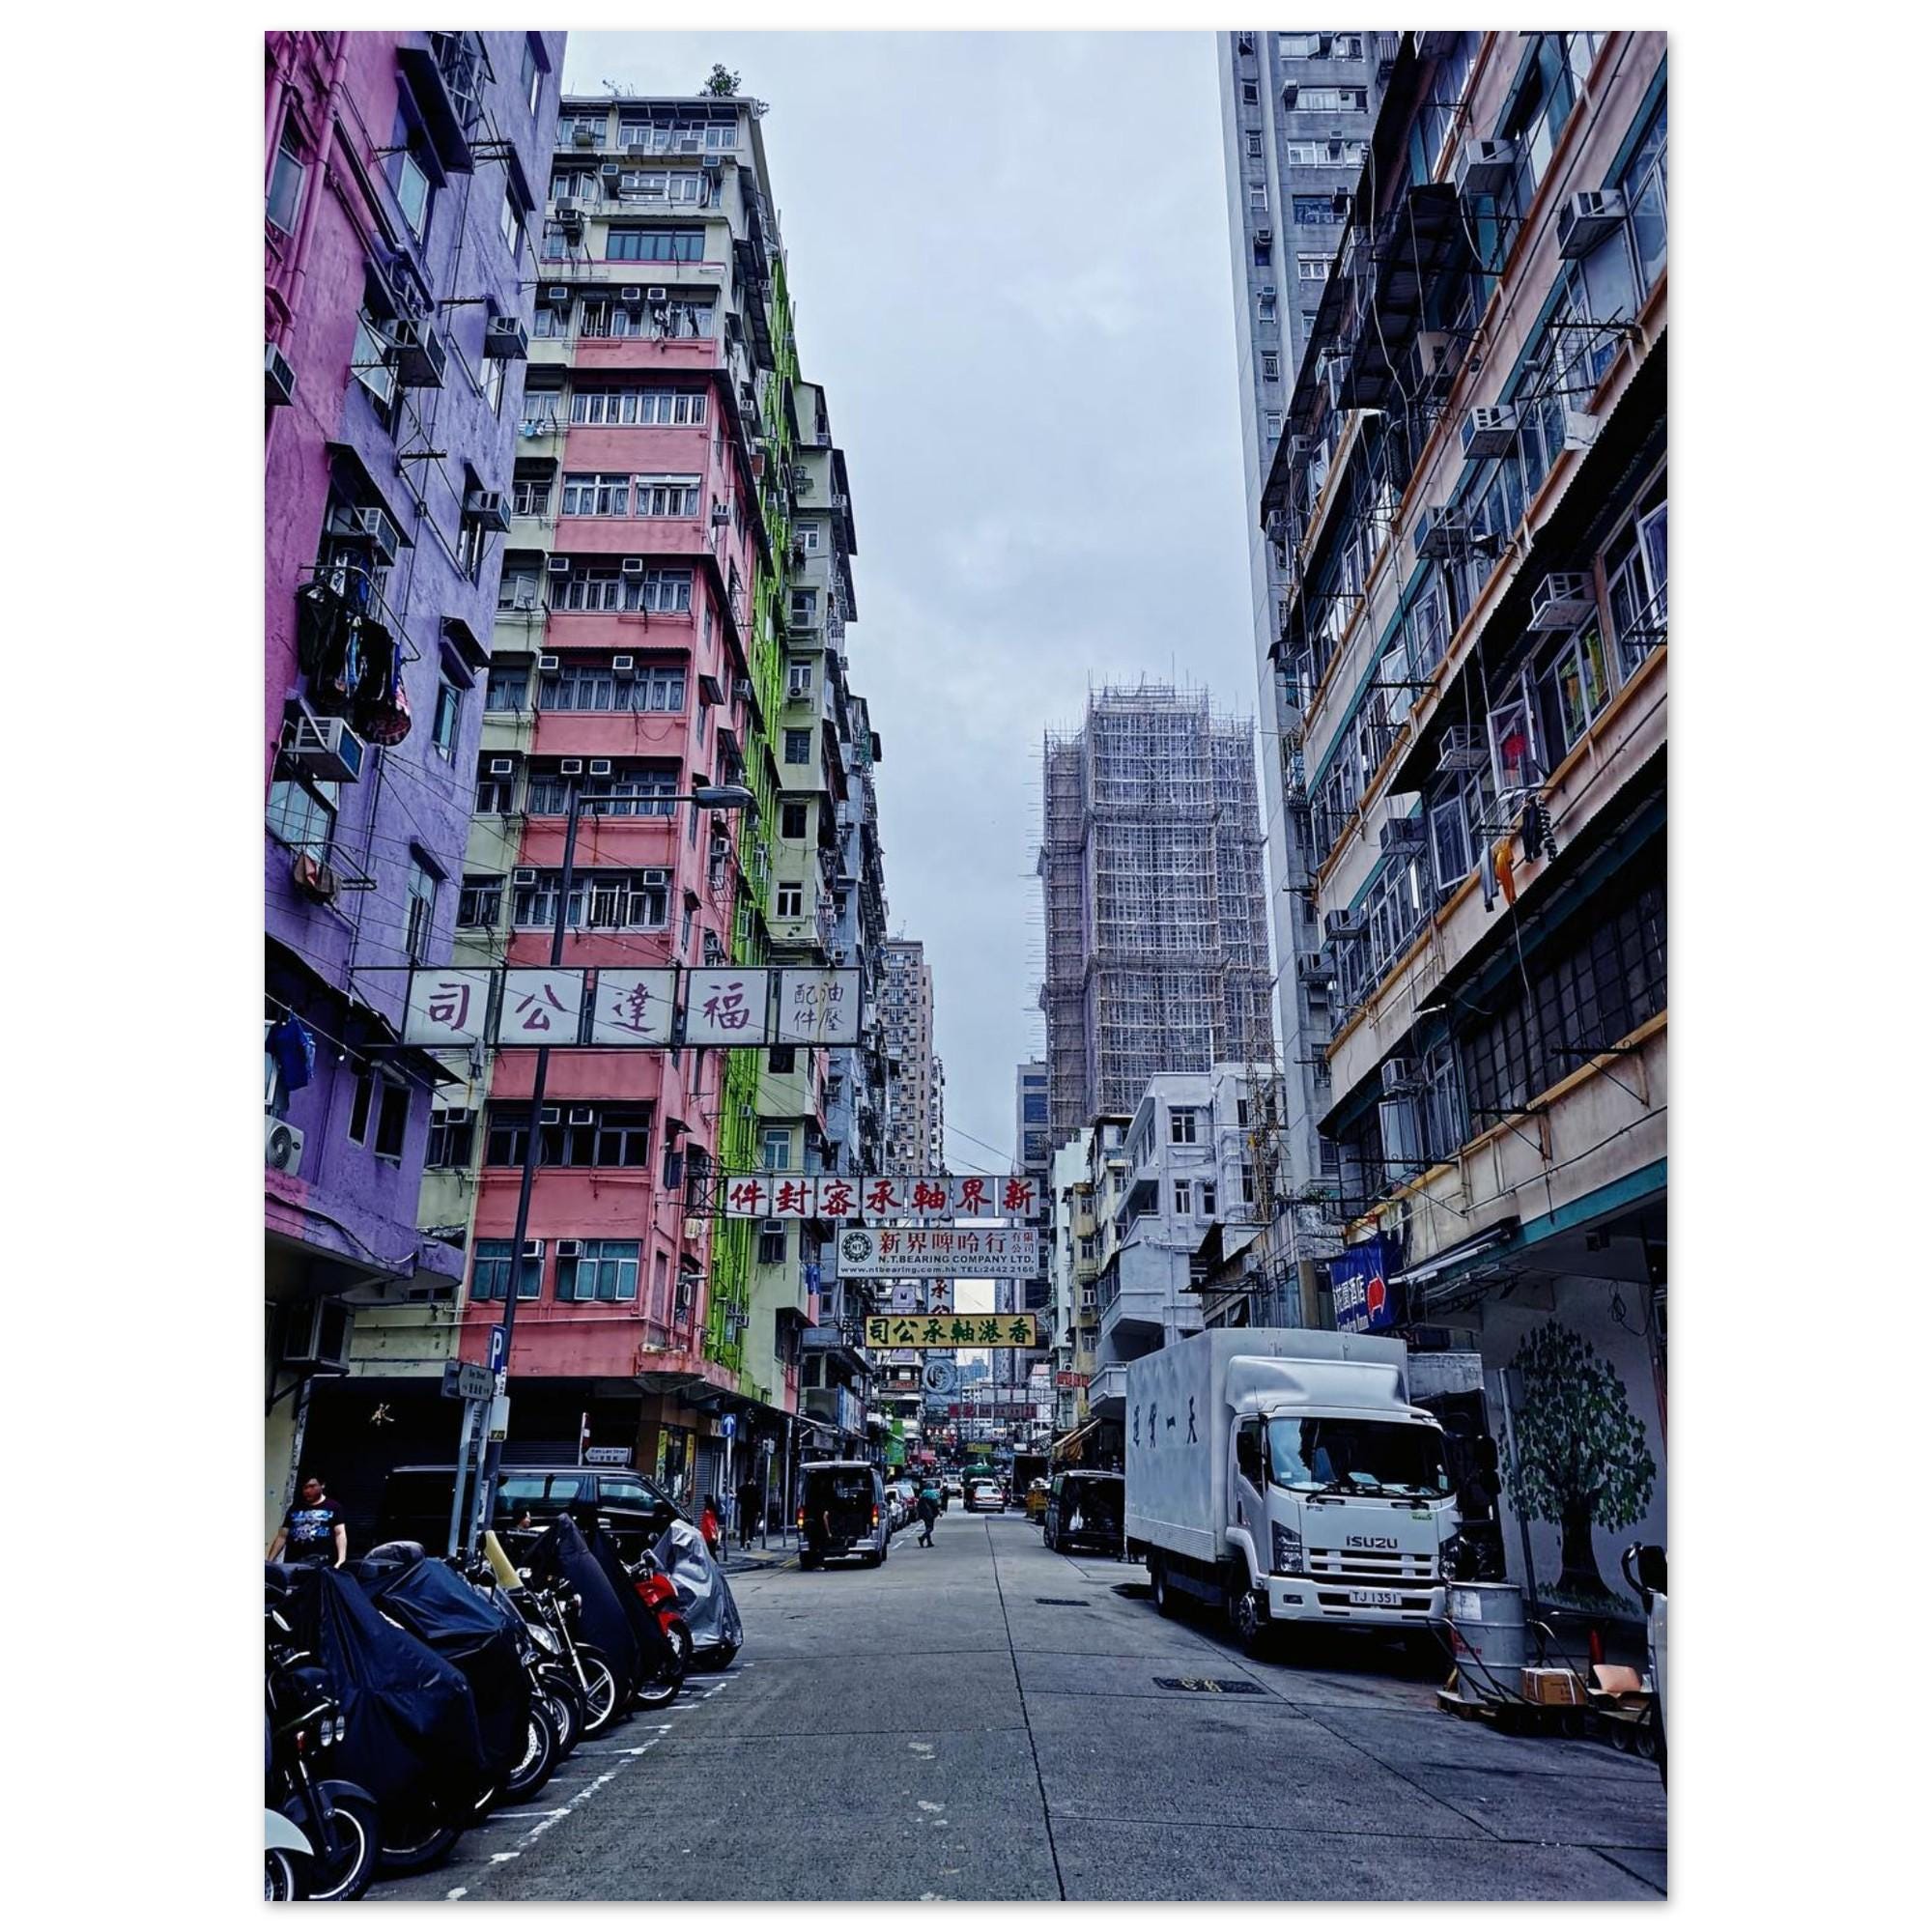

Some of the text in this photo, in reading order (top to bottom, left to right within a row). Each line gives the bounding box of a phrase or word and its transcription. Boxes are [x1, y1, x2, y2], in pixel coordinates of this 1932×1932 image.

[869, 1318, 1032, 1345] 香港軸承公司
[1346, 1535, 1399, 1548] ISUZU
[1352, 1591, 1398, 1604] TJ 1351
